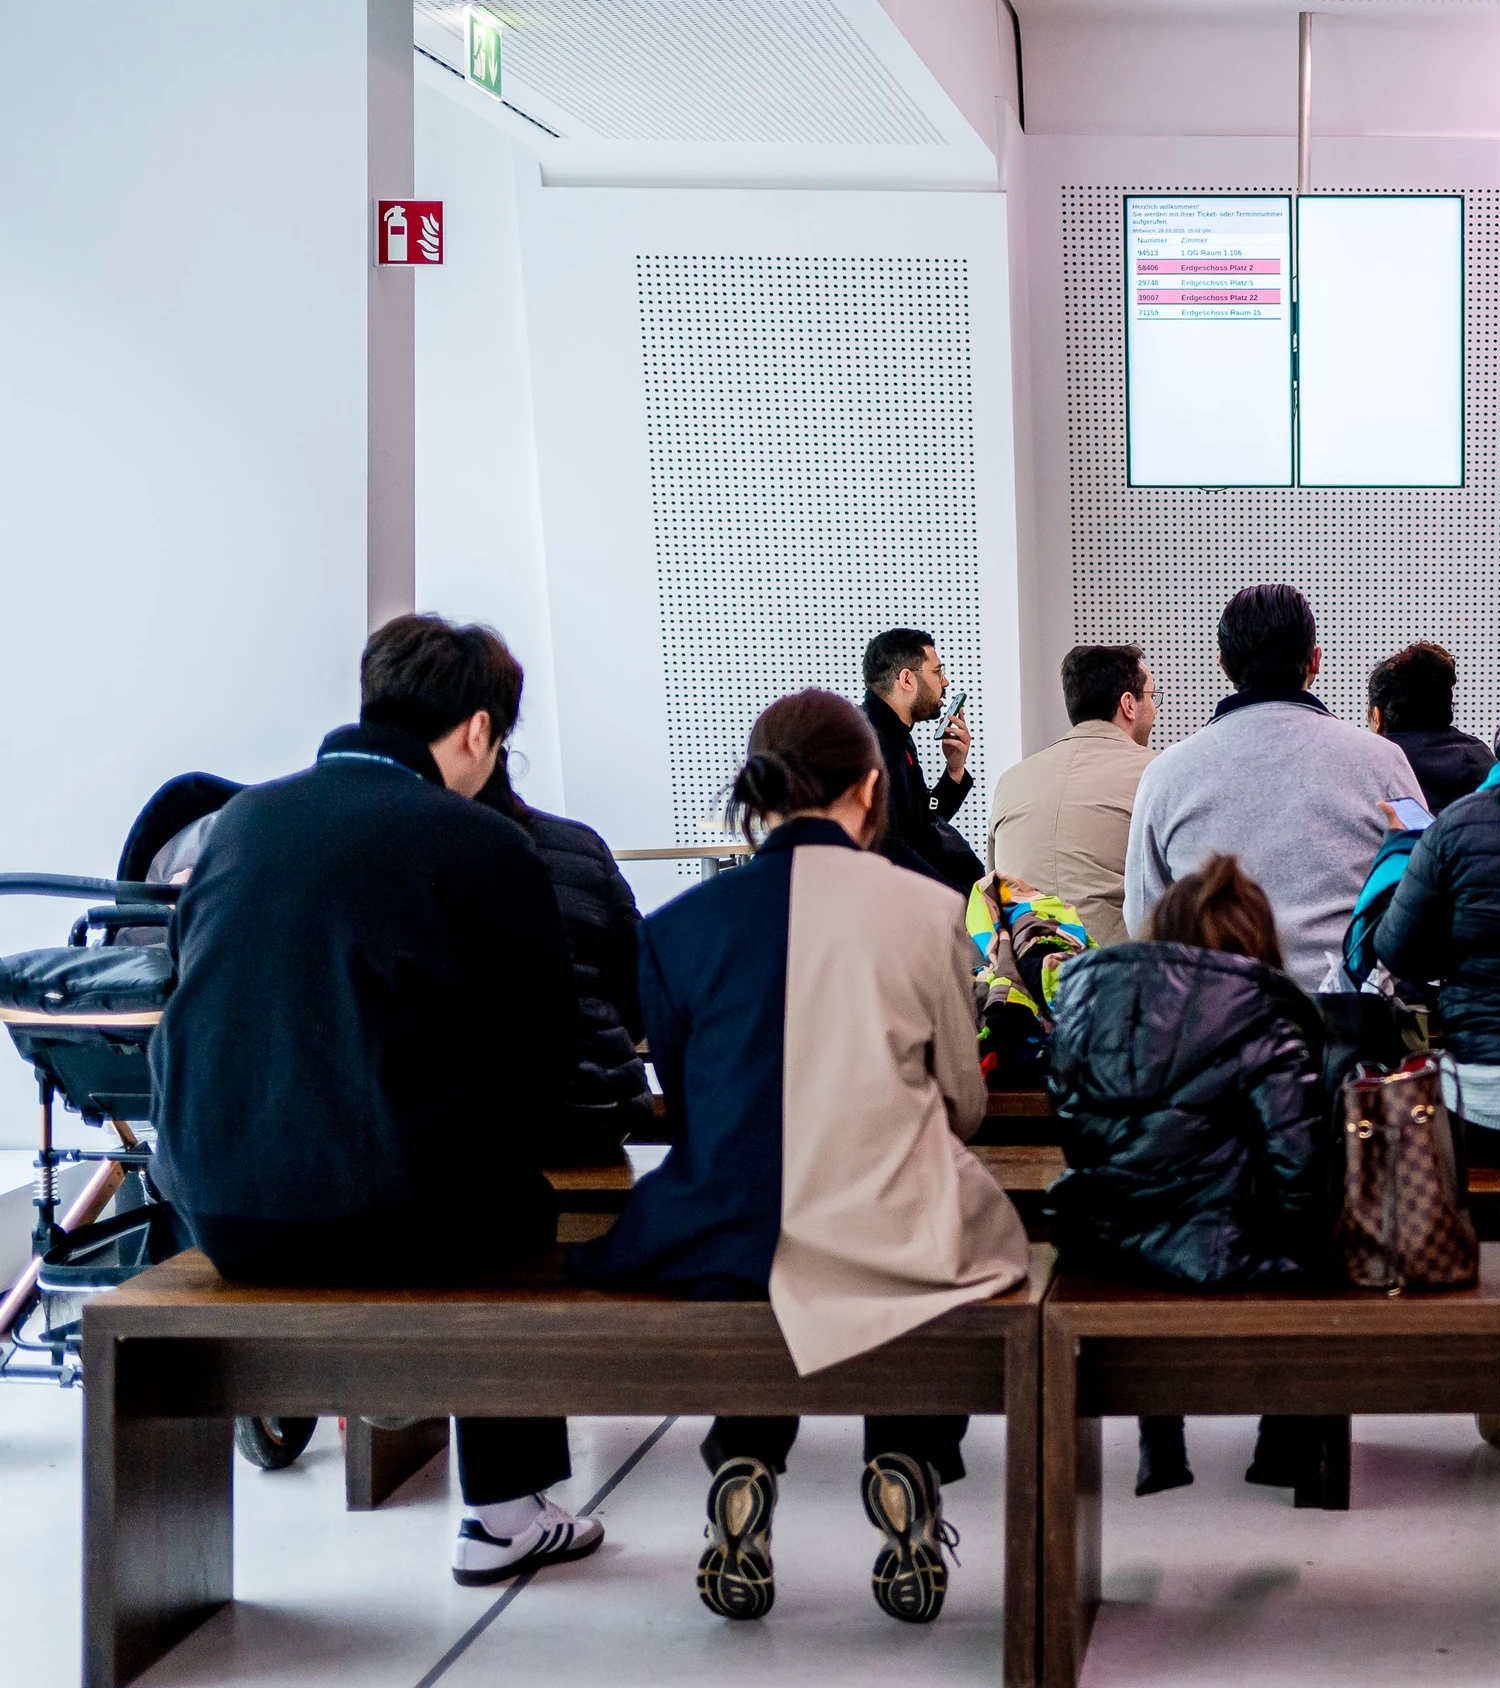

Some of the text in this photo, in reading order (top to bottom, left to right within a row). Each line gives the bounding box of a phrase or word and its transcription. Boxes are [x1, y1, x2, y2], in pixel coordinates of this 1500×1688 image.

[1180, 264, 1228, 272] Erdgeschoss
[1181, 279, 1228, 287] Erdgeschoss
[1181, 294, 1229, 302] Erdgeschoss
[1181, 309, 1229, 317] Erdgeschoss
